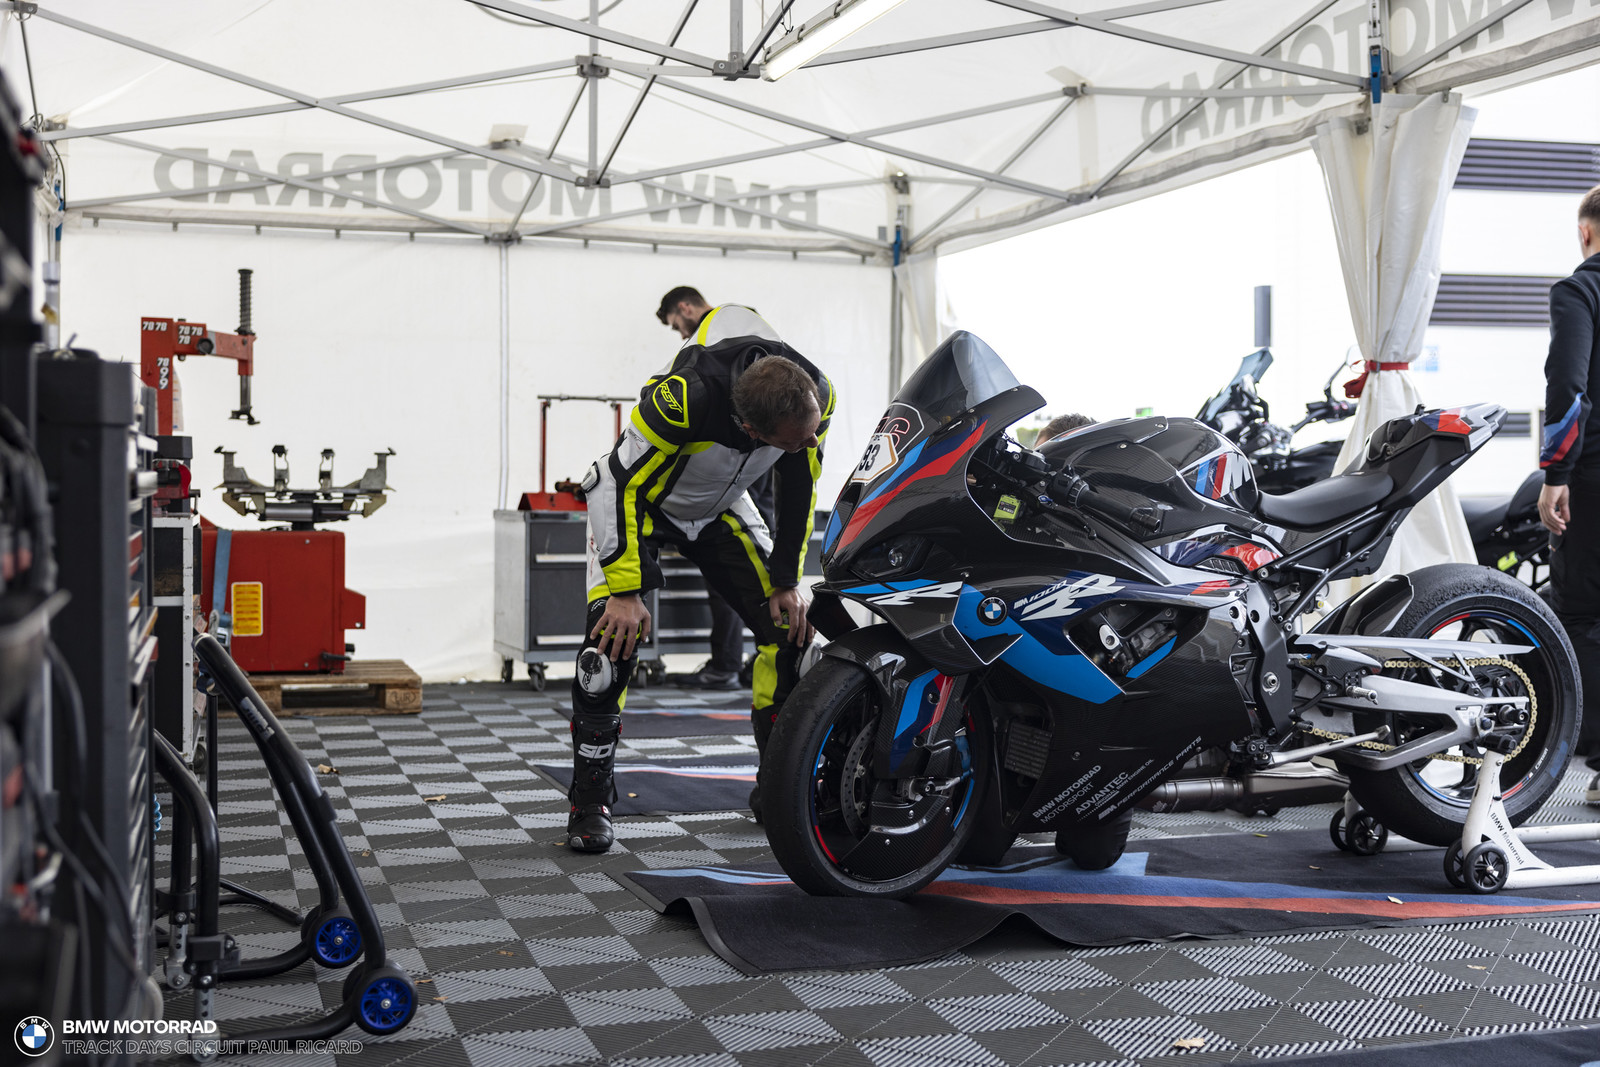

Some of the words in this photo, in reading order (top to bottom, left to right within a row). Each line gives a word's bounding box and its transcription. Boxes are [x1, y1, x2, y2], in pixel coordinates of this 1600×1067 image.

[159, 378, 169, 390] 9
[160, 367, 170, 379] 9
[660, 382, 683, 413] RST
[1020, 573, 1126, 621] RR
[1032, 799, 1057, 819] BMW
[1054, 764, 1102, 806] MOTORRAD
[1075, 771, 1129, 815] ADVANTEC
[1117, 760, 1175, 808] PERFORMANCE
[1175, 735, 1202, 761] PARTS
[1040, 781, 1095, 824] MOTORSPORT
[1490, 812, 1505, 832] BMW
[1502, 832, 1525, 866] Motorrad
